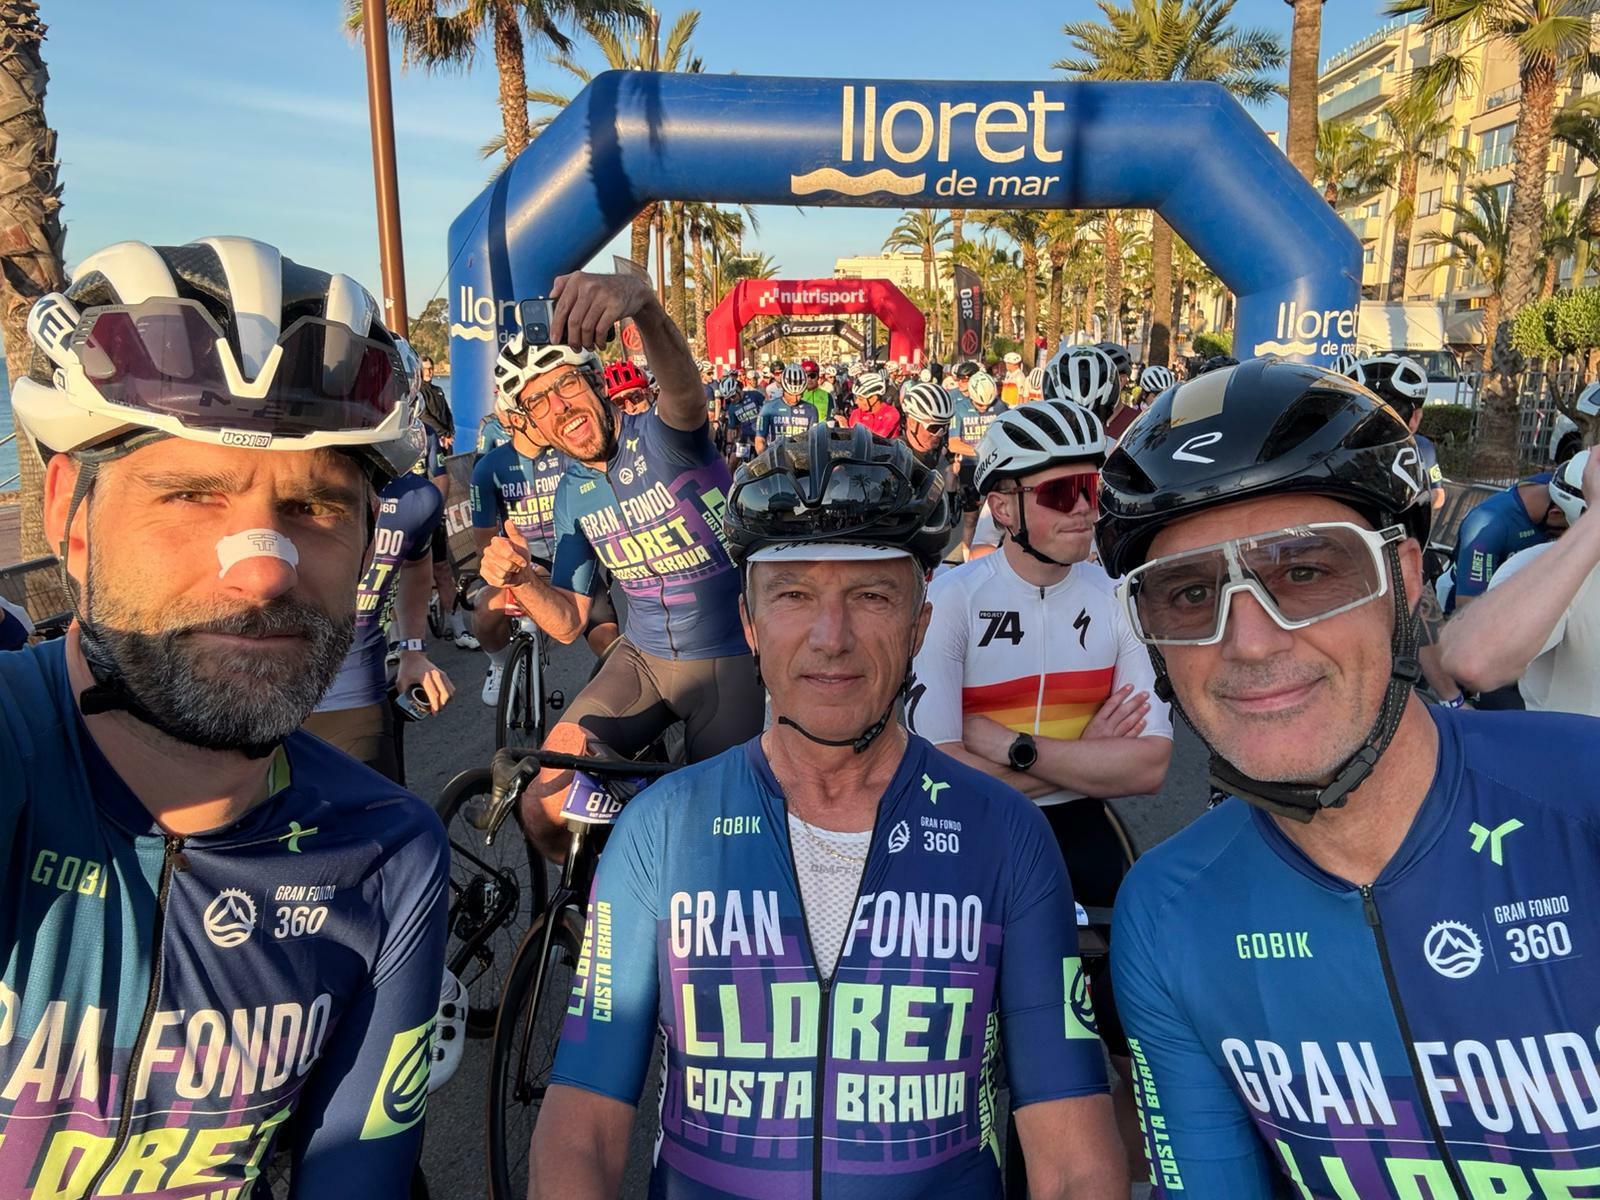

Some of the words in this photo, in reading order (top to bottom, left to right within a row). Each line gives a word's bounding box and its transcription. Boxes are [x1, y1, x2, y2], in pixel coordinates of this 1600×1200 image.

[841, 86, 1065, 163] lloret
[935, 169, 978, 197] de
[987, 176, 1060, 197] mar
[461, 286, 522, 326] llor
[781, 288, 866, 306] nutrisport
[791, 324, 835, 334] SCOTT
[1320, 340, 1338, 356] de
[501, 481, 531, 498] GRAN
[535, 472, 565, 494] FOND
[579, 505, 621, 540] GRAN
[620, 480, 677, 527] FONDO
[595, 515, 695, 569] LLORET
[652, 545, 711, 575] BRAVA
[1470, 549, 1485, 582] LLORET
[977, 610, 1025, 648] 74
[713, 815, 762, 836] GOBIK
[920, 815, 938, 830] GRAN
[939, 818, 963, 832] FONDO
[922, 831, 960, 855] 360
[30, 848, 108, 898] GOBI
[274, 884, 306, 902] GRAN
[1494, 903, 1527, 925] GRAN
[1527, 895, 1570, 920] FONDO
[274, 906, 329, 940] 360
[596, 901, 612, 960] BRAVA
[669, 889, 785, 958] GRAN
[843, 890, 984, 962] FONDO
[1505, 920, 1574, 964] 360
[1235, 931, 1314, 960] GOBIK
[592, 963, 613, 1023] COSTA
[682, 981, 975, 1062] LLORET
[133, 993, 333, 1102] FONDO
[1127, 1037, 1161, 1110] BRAVA
[1221, 1037, 1398, 1127] GRAN
[1413, 1025, 1600, 1135] FOND
[685, 1065, 815, 1120] COSTA
[834, 1070, 968, 1124] BRAVA
[1150, 1115, 1185, 1191] COSTA
